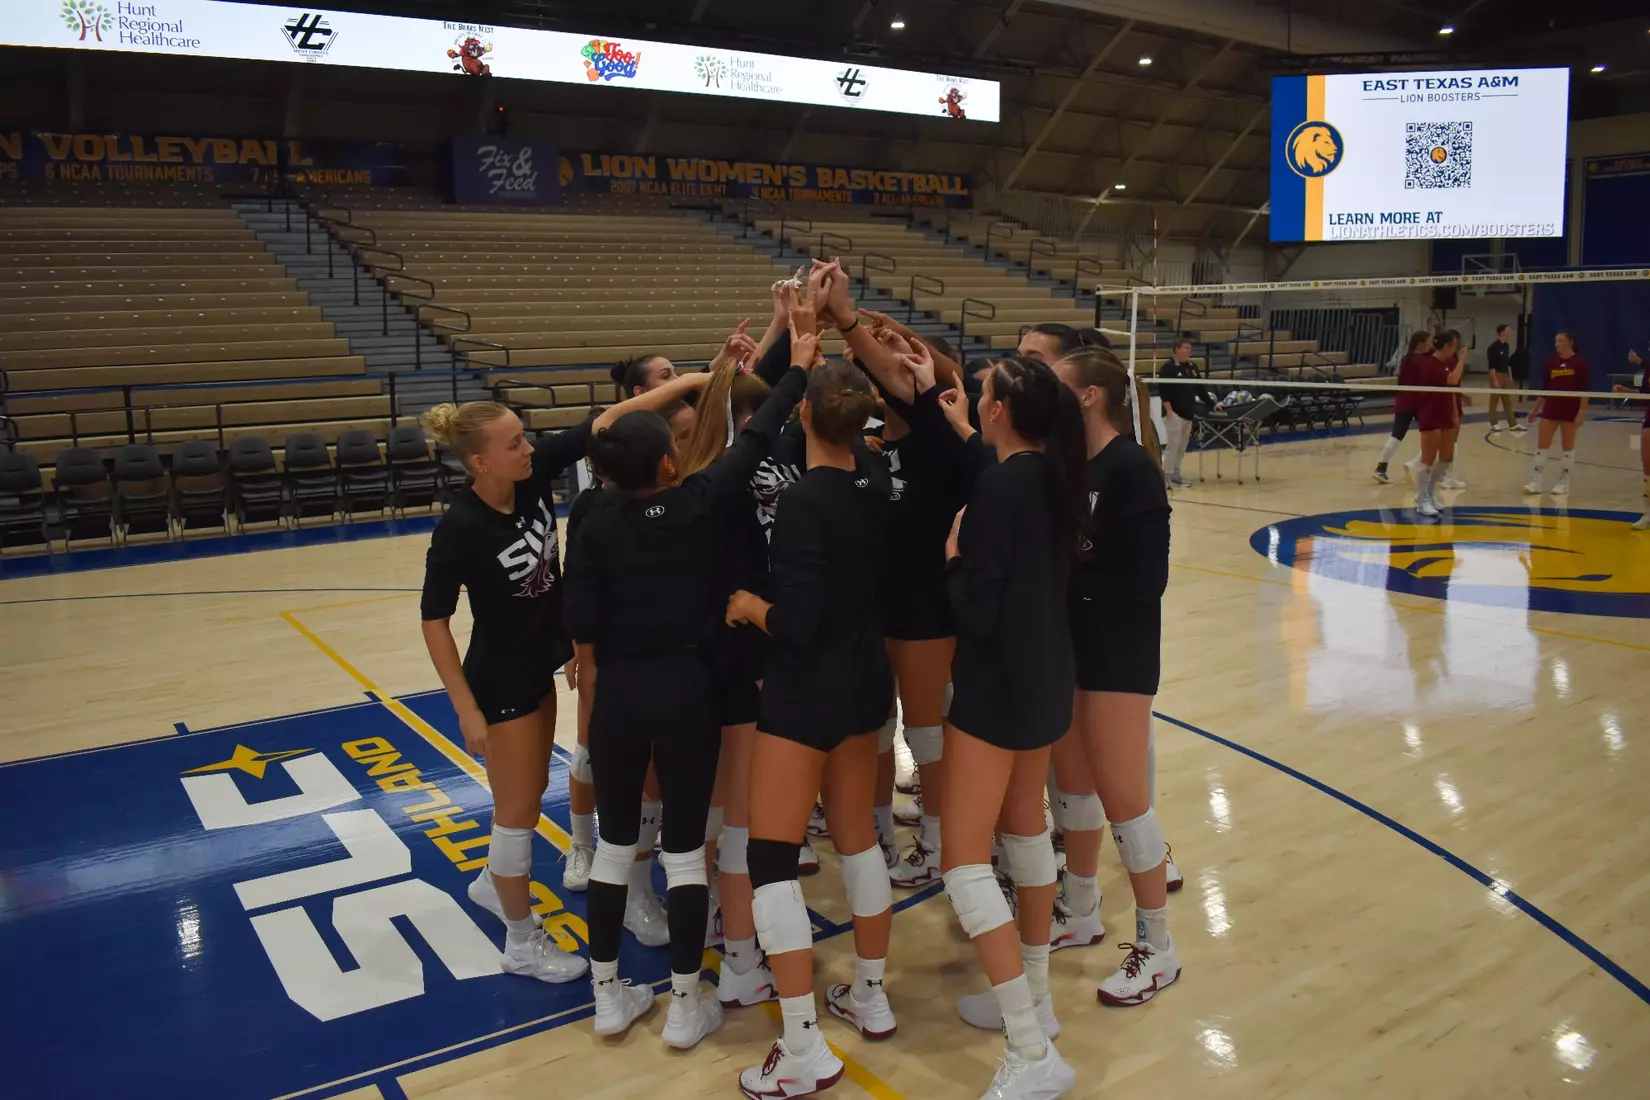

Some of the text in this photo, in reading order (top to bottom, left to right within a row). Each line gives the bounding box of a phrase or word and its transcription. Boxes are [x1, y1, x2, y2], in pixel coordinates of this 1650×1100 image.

[117, 1, 157, 17] Hunt
[118, 16, 183, 35] Regional
[119, 31, 201, 48] Healthcare
[604, 42, 635, 63] Too
[730, 57, 755, 69] Hunt
[730, 68, 772, 82] Regional
[1362, 75, 1520, 92] EAST TEXAS A&M
[730, 80, 783, 94] Healthcare
[1400, 92, 1481, 103] LION BOOSTERS
[477, 145, 533, 177] Fix &
[60, 163, 101, 181] NCAA
[106, 164, 214, 183] TOURNAMENTS
[487, 168, 538, 195] Feed
[580, 153, 969, 196] LION WOMEN'S BASKETBALL
[1328, 211, 1444, 226] LEARN MORE AT
[341, 736, 590, 954] SOTHLAND
[180, 752, 505, 1023] SLC
